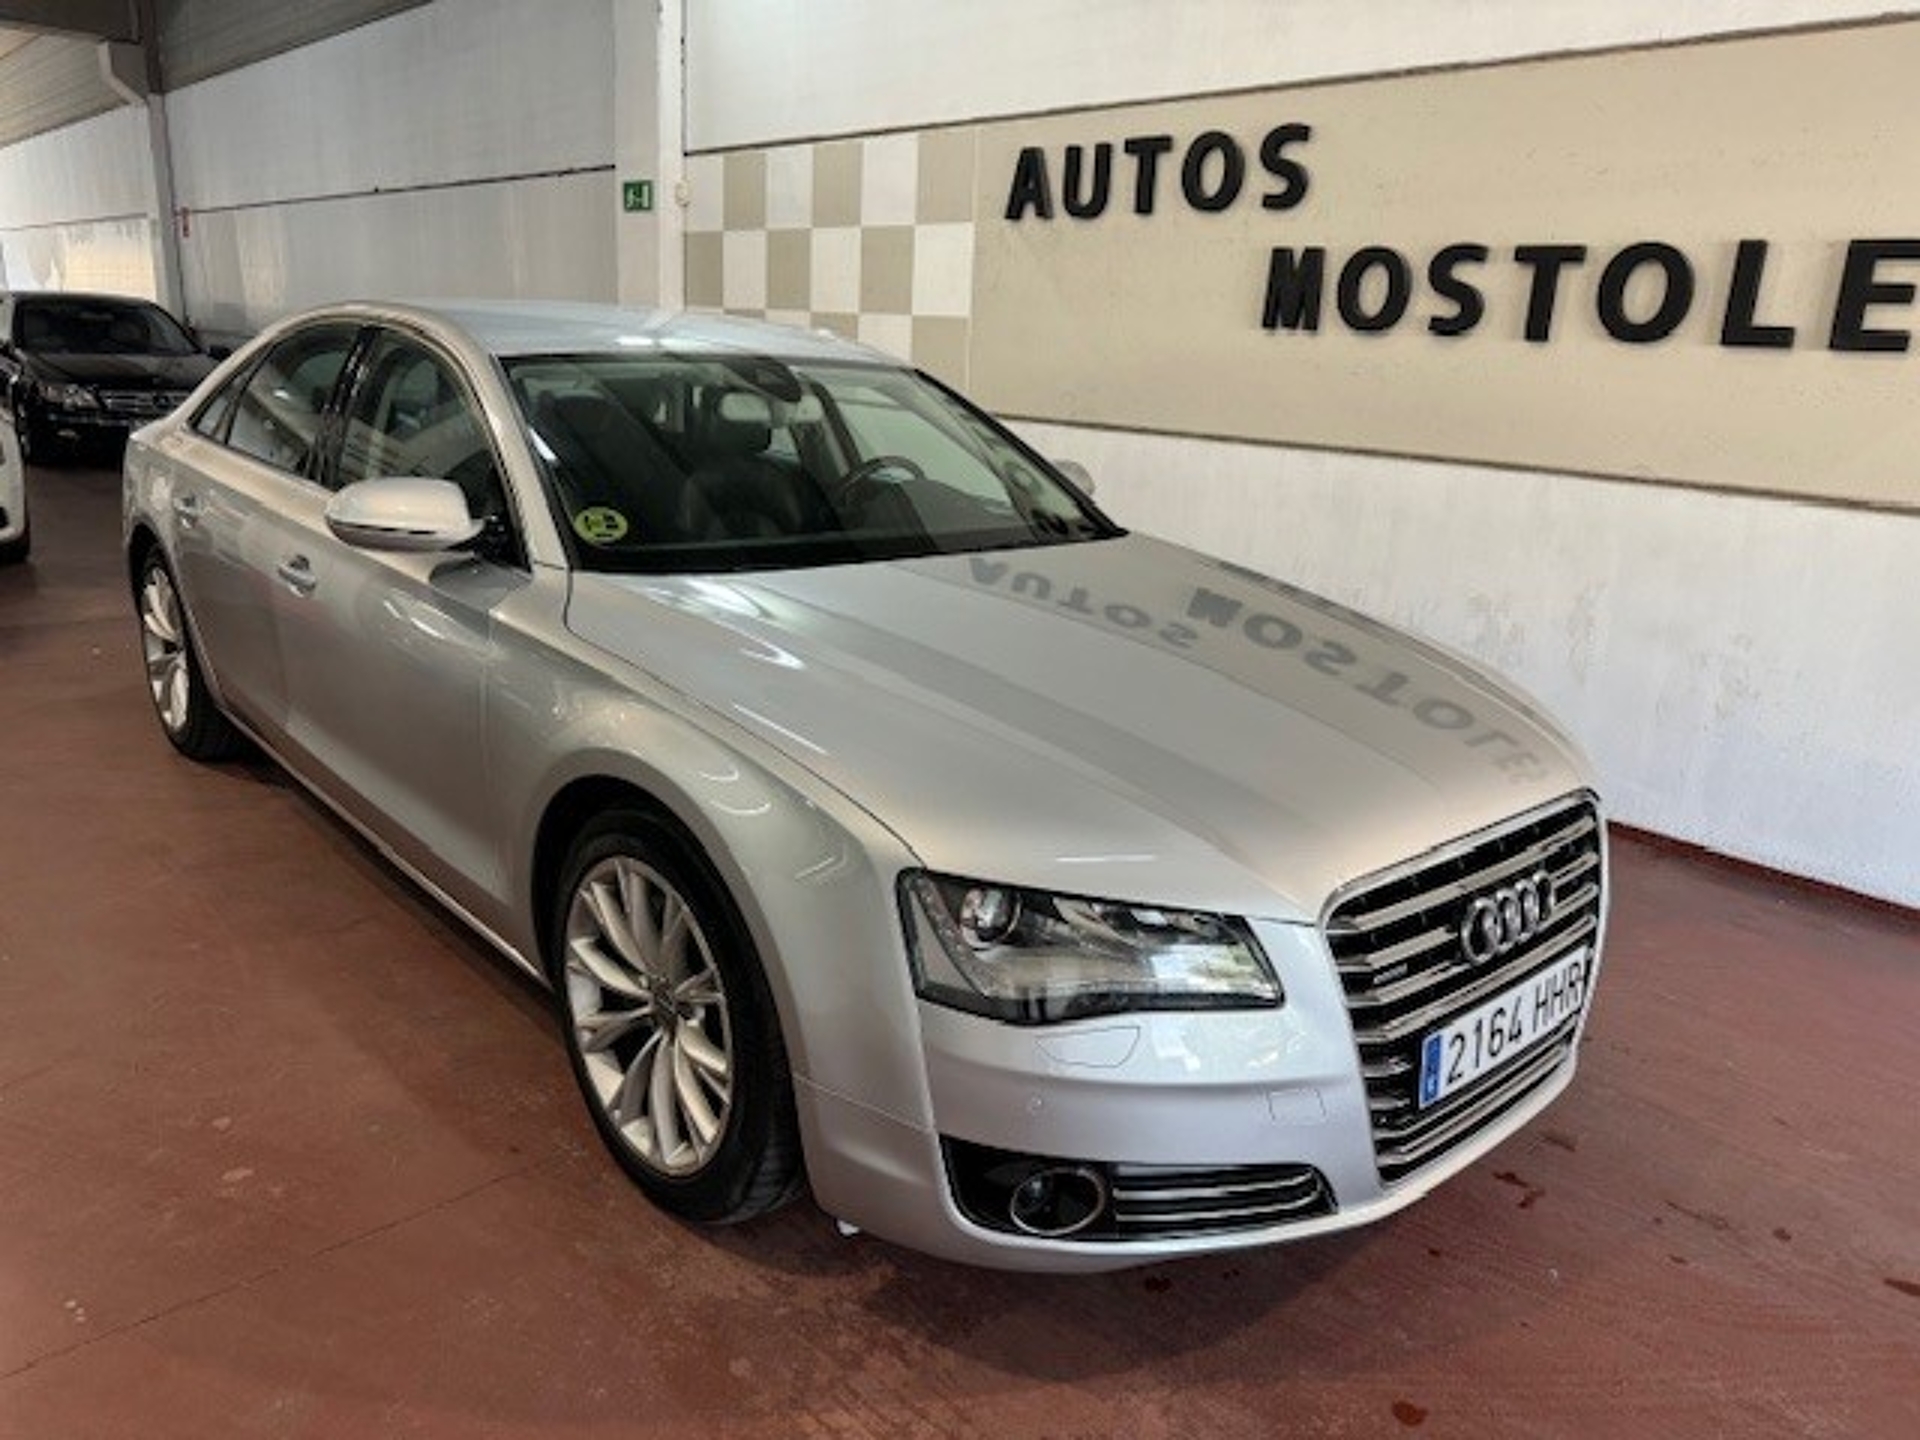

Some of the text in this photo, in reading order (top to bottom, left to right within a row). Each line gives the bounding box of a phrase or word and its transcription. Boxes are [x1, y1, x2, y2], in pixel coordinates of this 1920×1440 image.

[1005, 123, 1312, 220] AUTOS
[1262, 239, 1920, 352] MOSTOLE
[1448, 962, 1583, 1083] 2164 HHR
